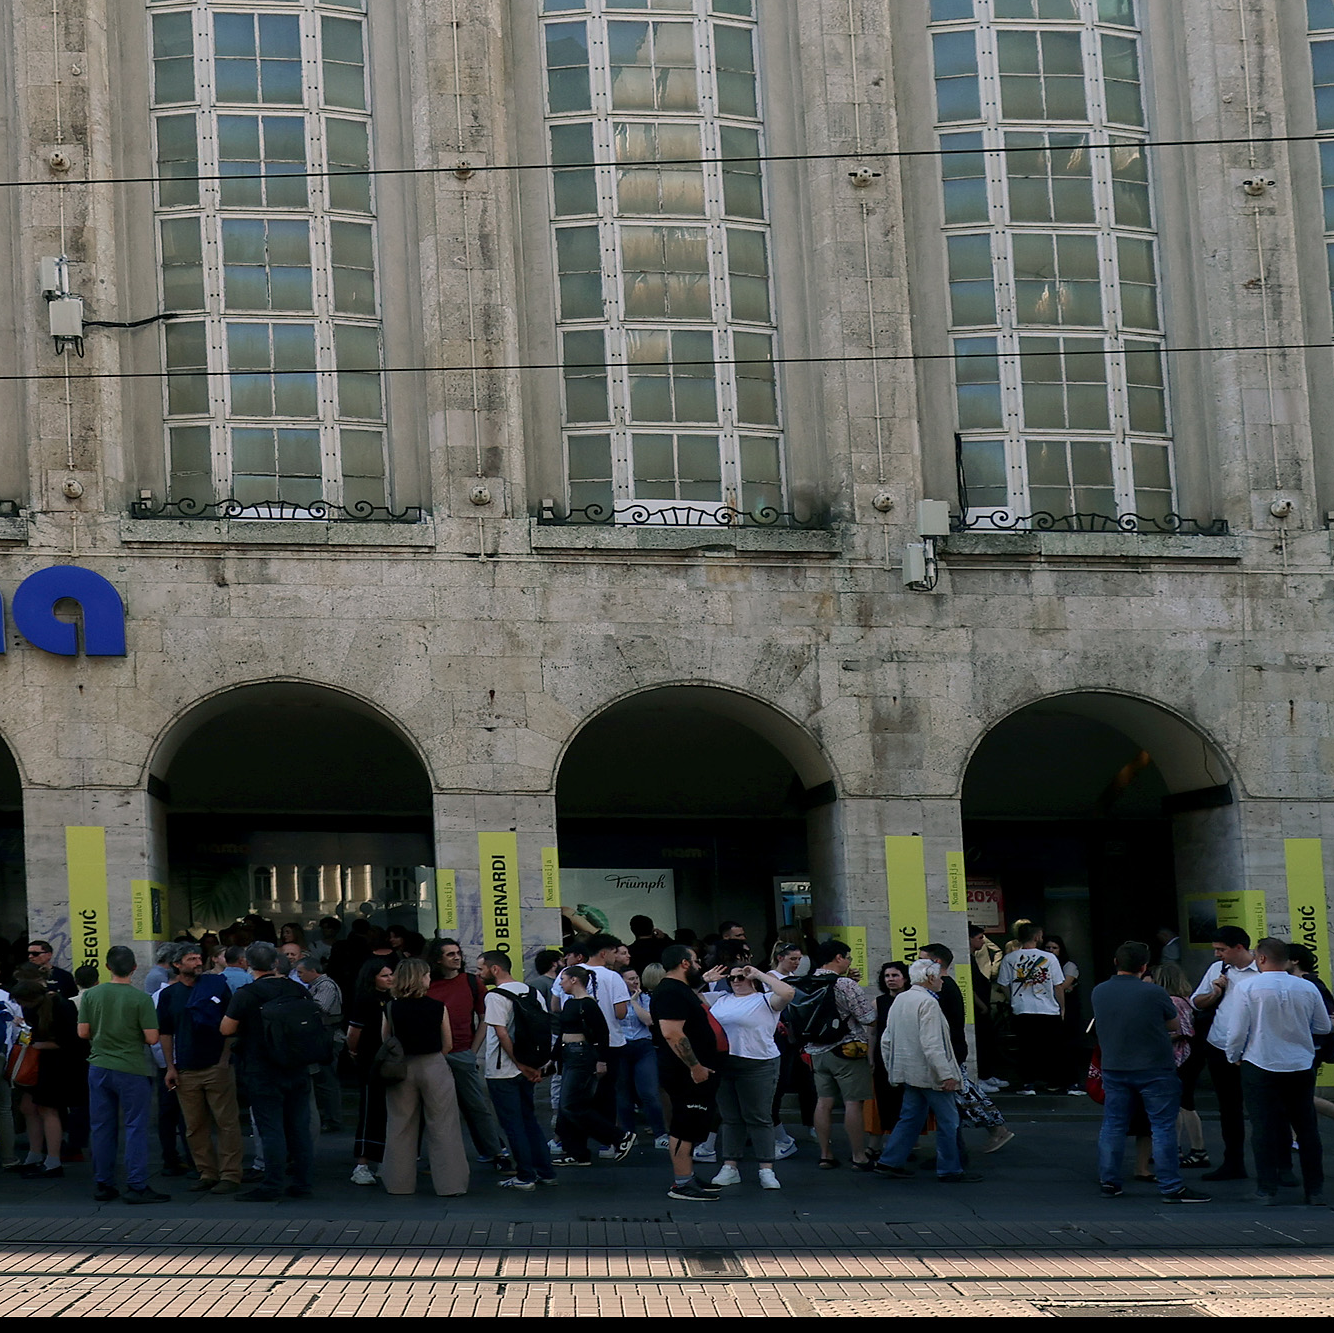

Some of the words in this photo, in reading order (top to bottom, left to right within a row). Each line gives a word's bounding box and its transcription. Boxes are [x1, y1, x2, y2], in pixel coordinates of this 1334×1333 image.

[492, 855, 510, 938] BERNARDI
[545, 859, 554, 901] Nominacija
[605, 874, 666, 893] Triumph
[950, 863, 960, 905] Nominacija
[135, 892, 144, 934] Nominacija
[445, 882, 454, 924] Nominacija
[1255, 903, 1264, 939] ominacija
[79, 909, 100, 971] ŠEGVIĆ
[899, 926, 918, 966] ALIĆ
